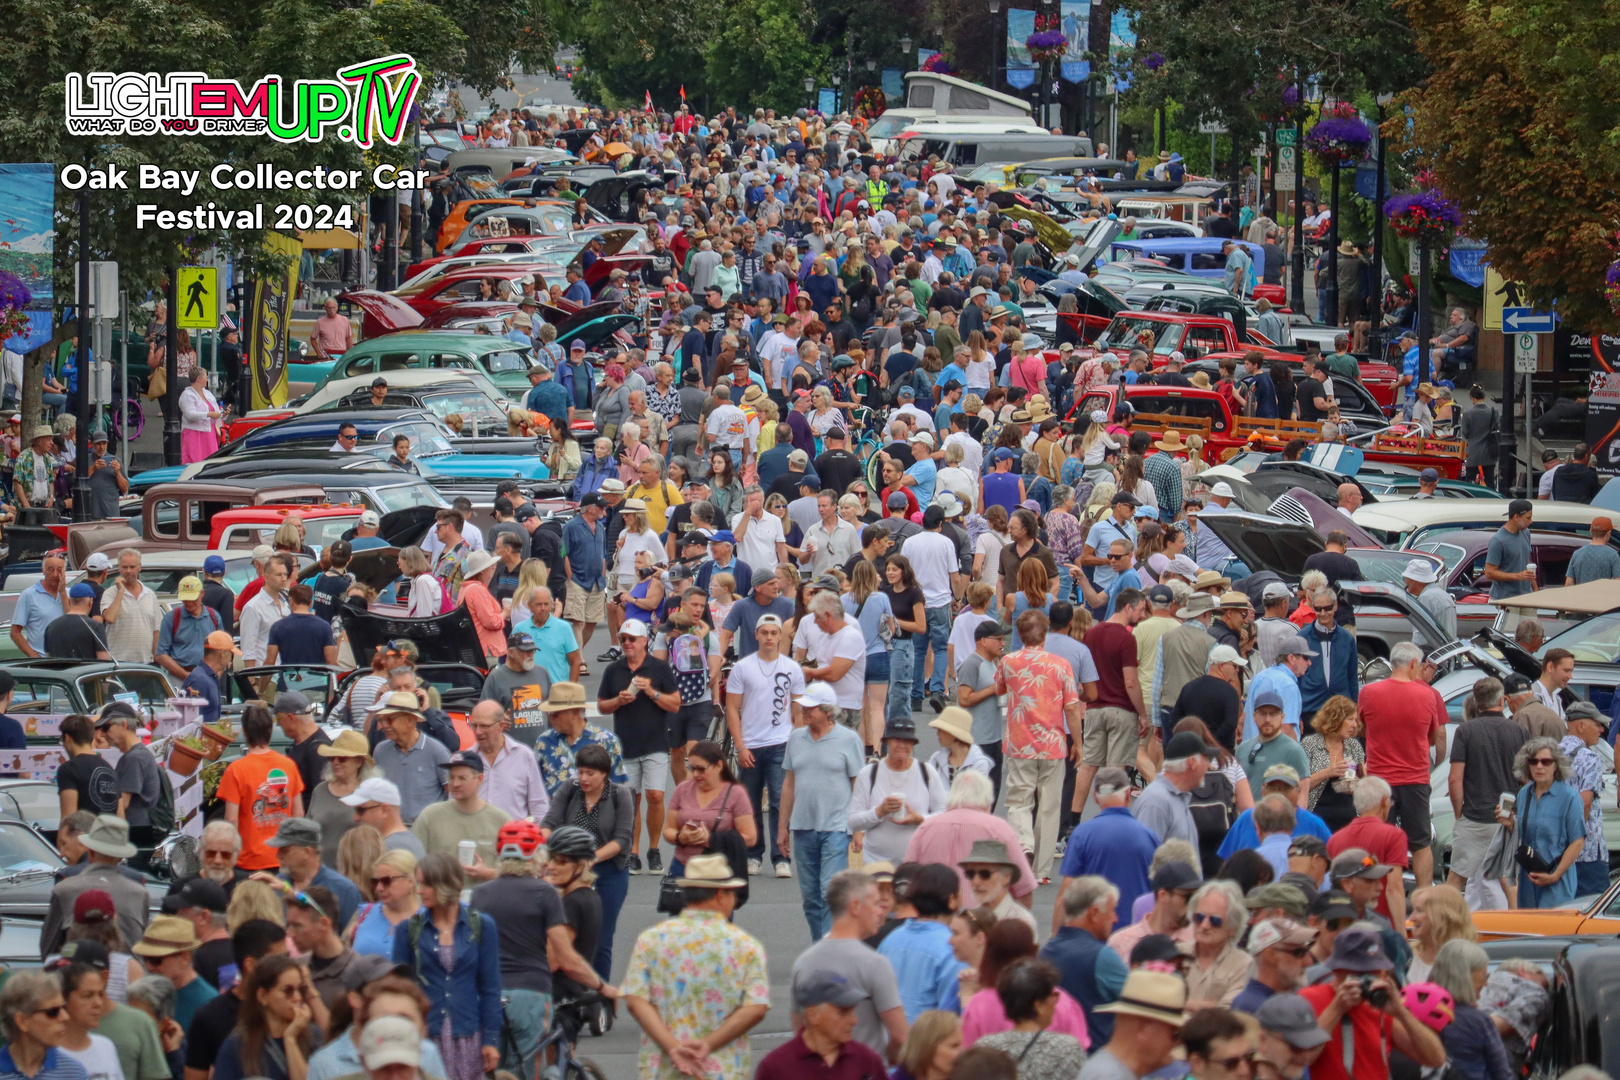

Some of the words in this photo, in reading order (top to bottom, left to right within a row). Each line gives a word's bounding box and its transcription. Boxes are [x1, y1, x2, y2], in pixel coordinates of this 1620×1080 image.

[275, 352, 284, 369] THE
[771, 672, 792, 728] Coors
[513, 711, 543, 719] LAGUNA
